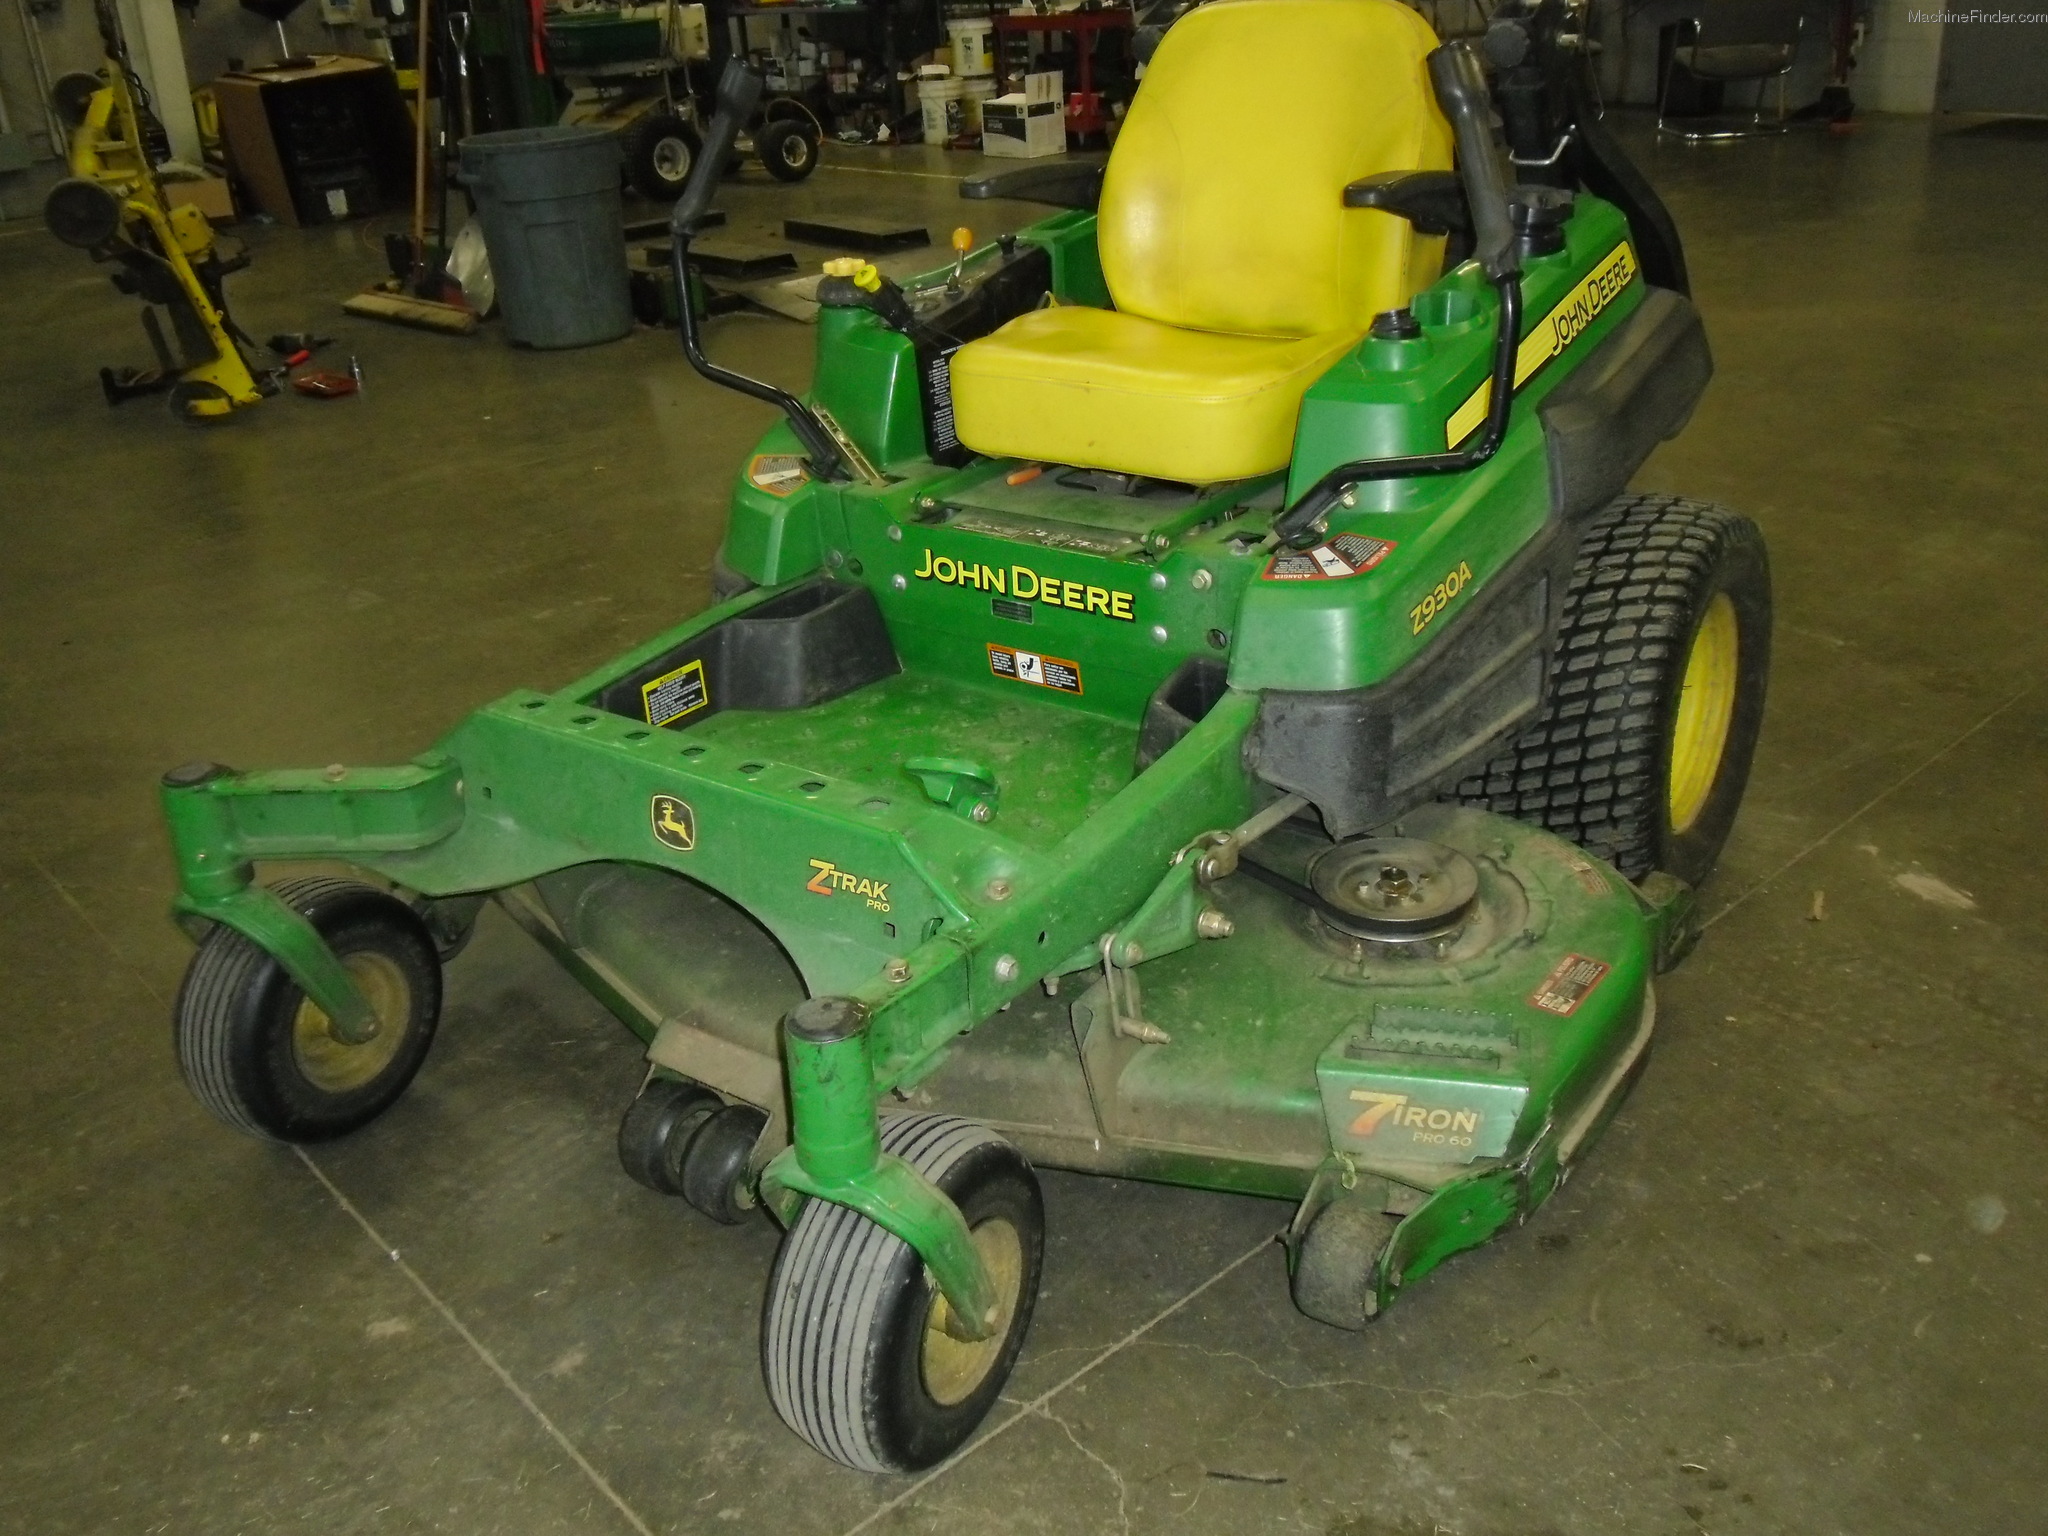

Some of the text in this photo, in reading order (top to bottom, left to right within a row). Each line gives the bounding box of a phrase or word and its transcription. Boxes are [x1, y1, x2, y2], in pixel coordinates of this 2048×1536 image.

[1552, 254, 1631, 354] JOHN DEERE
[914, 548, 1136, 622] JOHN DEERE
[1410, 560, 1473, 636] Z930A
[866, 898, 891, 913] PRO
[1412, 1131, 1472, 1147] PRO 60
